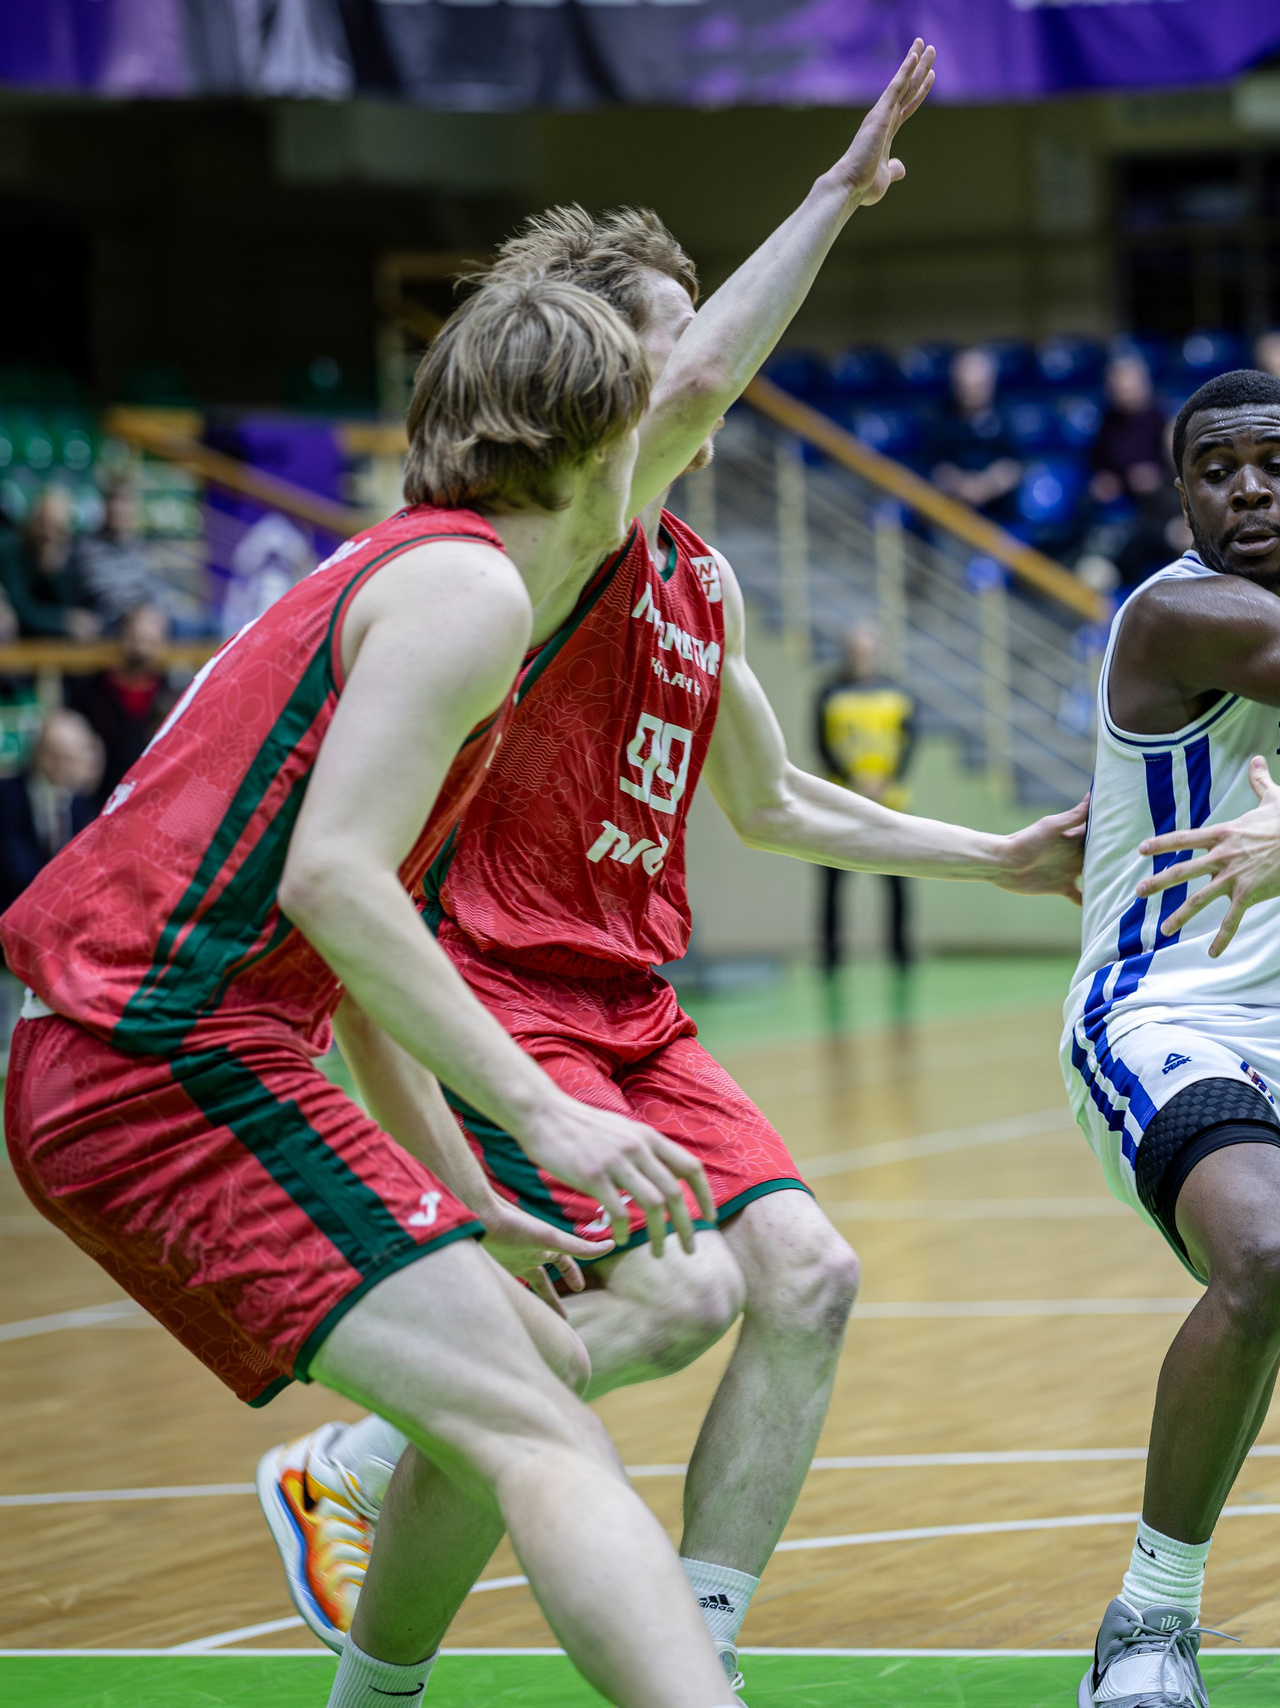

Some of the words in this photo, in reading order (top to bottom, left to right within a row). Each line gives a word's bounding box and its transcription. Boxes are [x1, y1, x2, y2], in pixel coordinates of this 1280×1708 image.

[620, 712, 693, 816] 99
[1161, 1055, 1193, 1076] PEAK
[698, 1600, 735, 1613] didas
